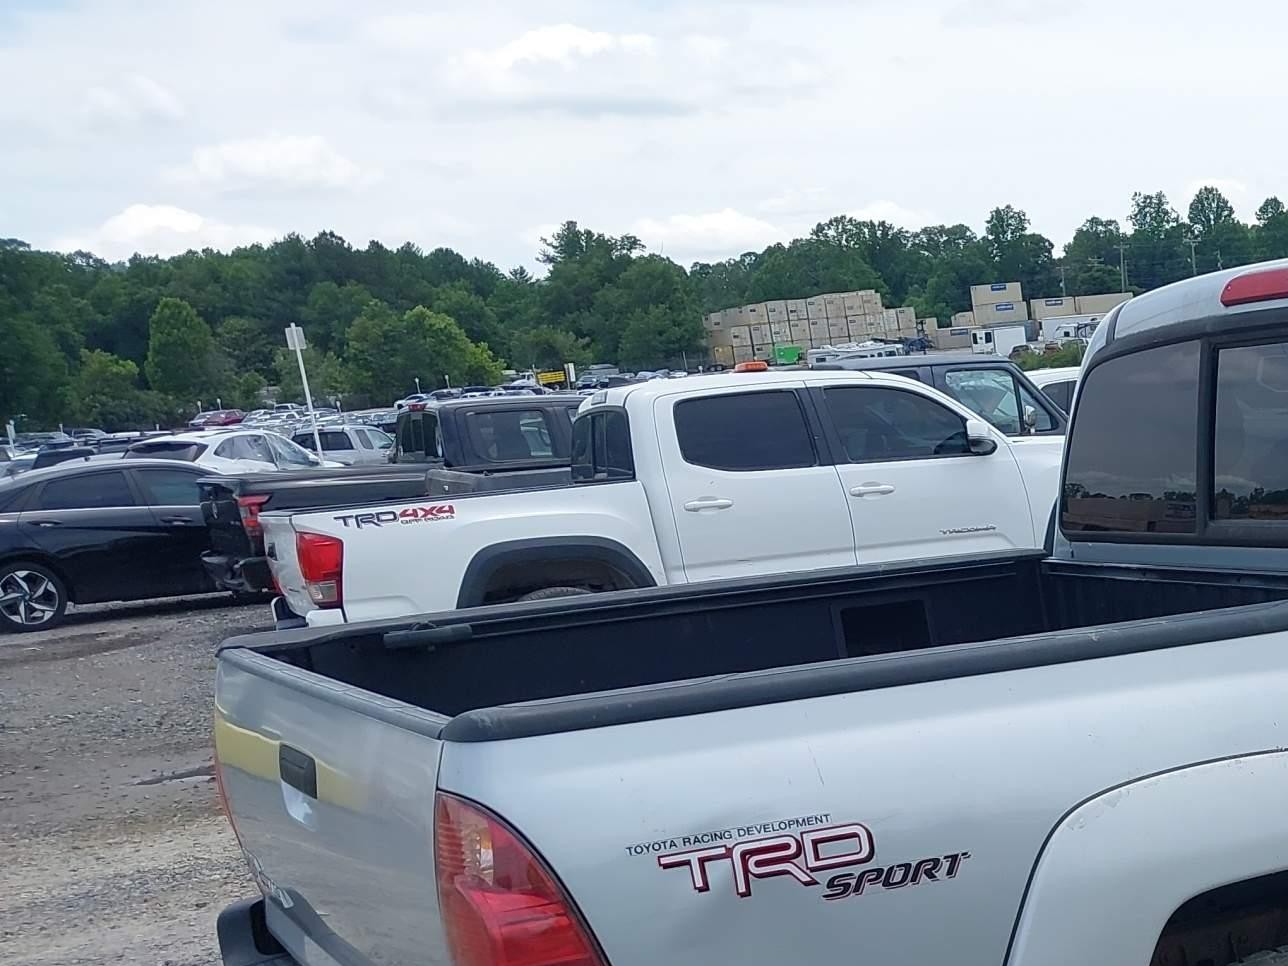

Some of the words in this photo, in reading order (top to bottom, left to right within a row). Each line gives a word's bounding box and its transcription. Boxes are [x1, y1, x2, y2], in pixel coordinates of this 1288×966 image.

[334, 511, 398, 529] TRD
[625, 840, 679, 857] TOYOTA
[682, 829, 733, 848] RACING
[737, 813, 831, 839] DEVELOPMENT
[657, 822, 875, 898] TRD
[821, 851, 973, 901] SPORT
